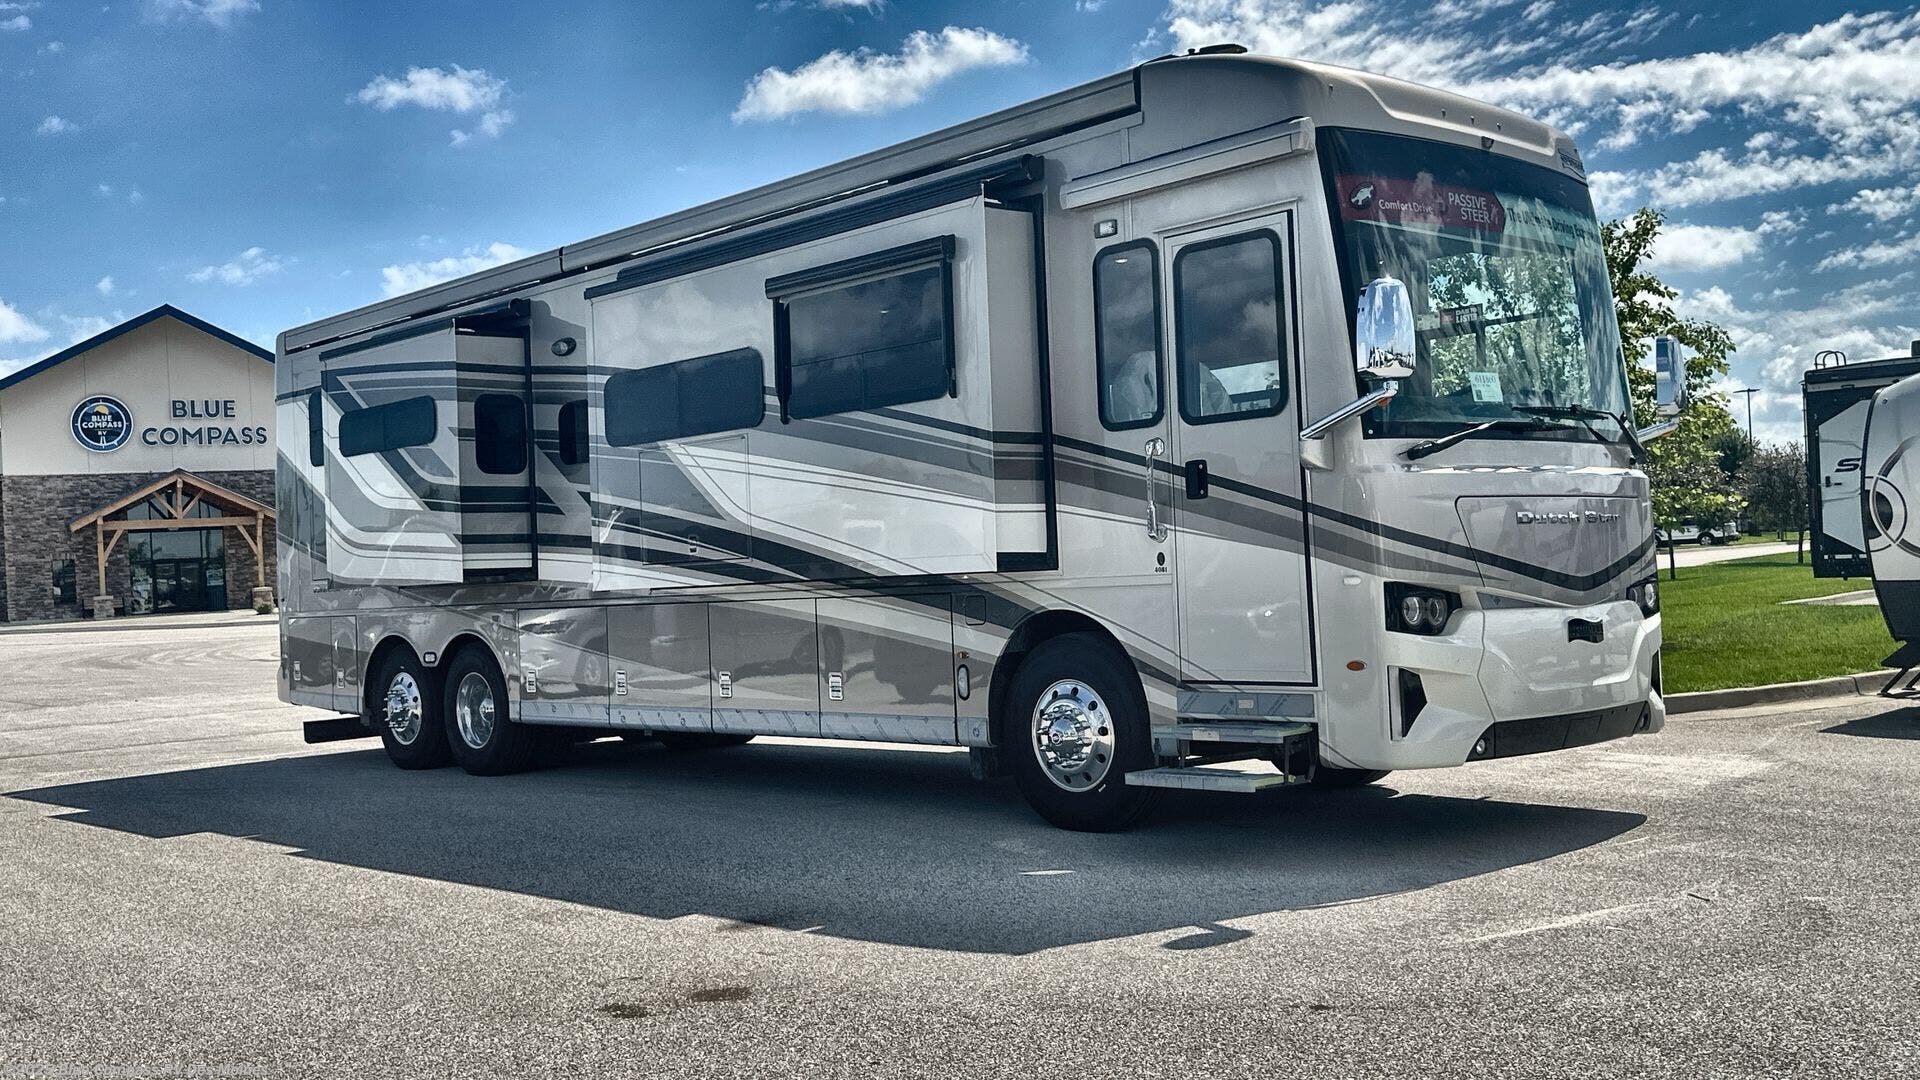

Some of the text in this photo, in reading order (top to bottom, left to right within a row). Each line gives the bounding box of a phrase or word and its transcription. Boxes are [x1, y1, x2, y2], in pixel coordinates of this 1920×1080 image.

[1448, 192, 1487, 210] PASSIVE
[1460, 208, 1491, 224] STEER
[172, 400, 235, 418] BLUE
[142, 427, 268, 445] COMPASS
[1517, 510, 1621, 525] Dutch Star
